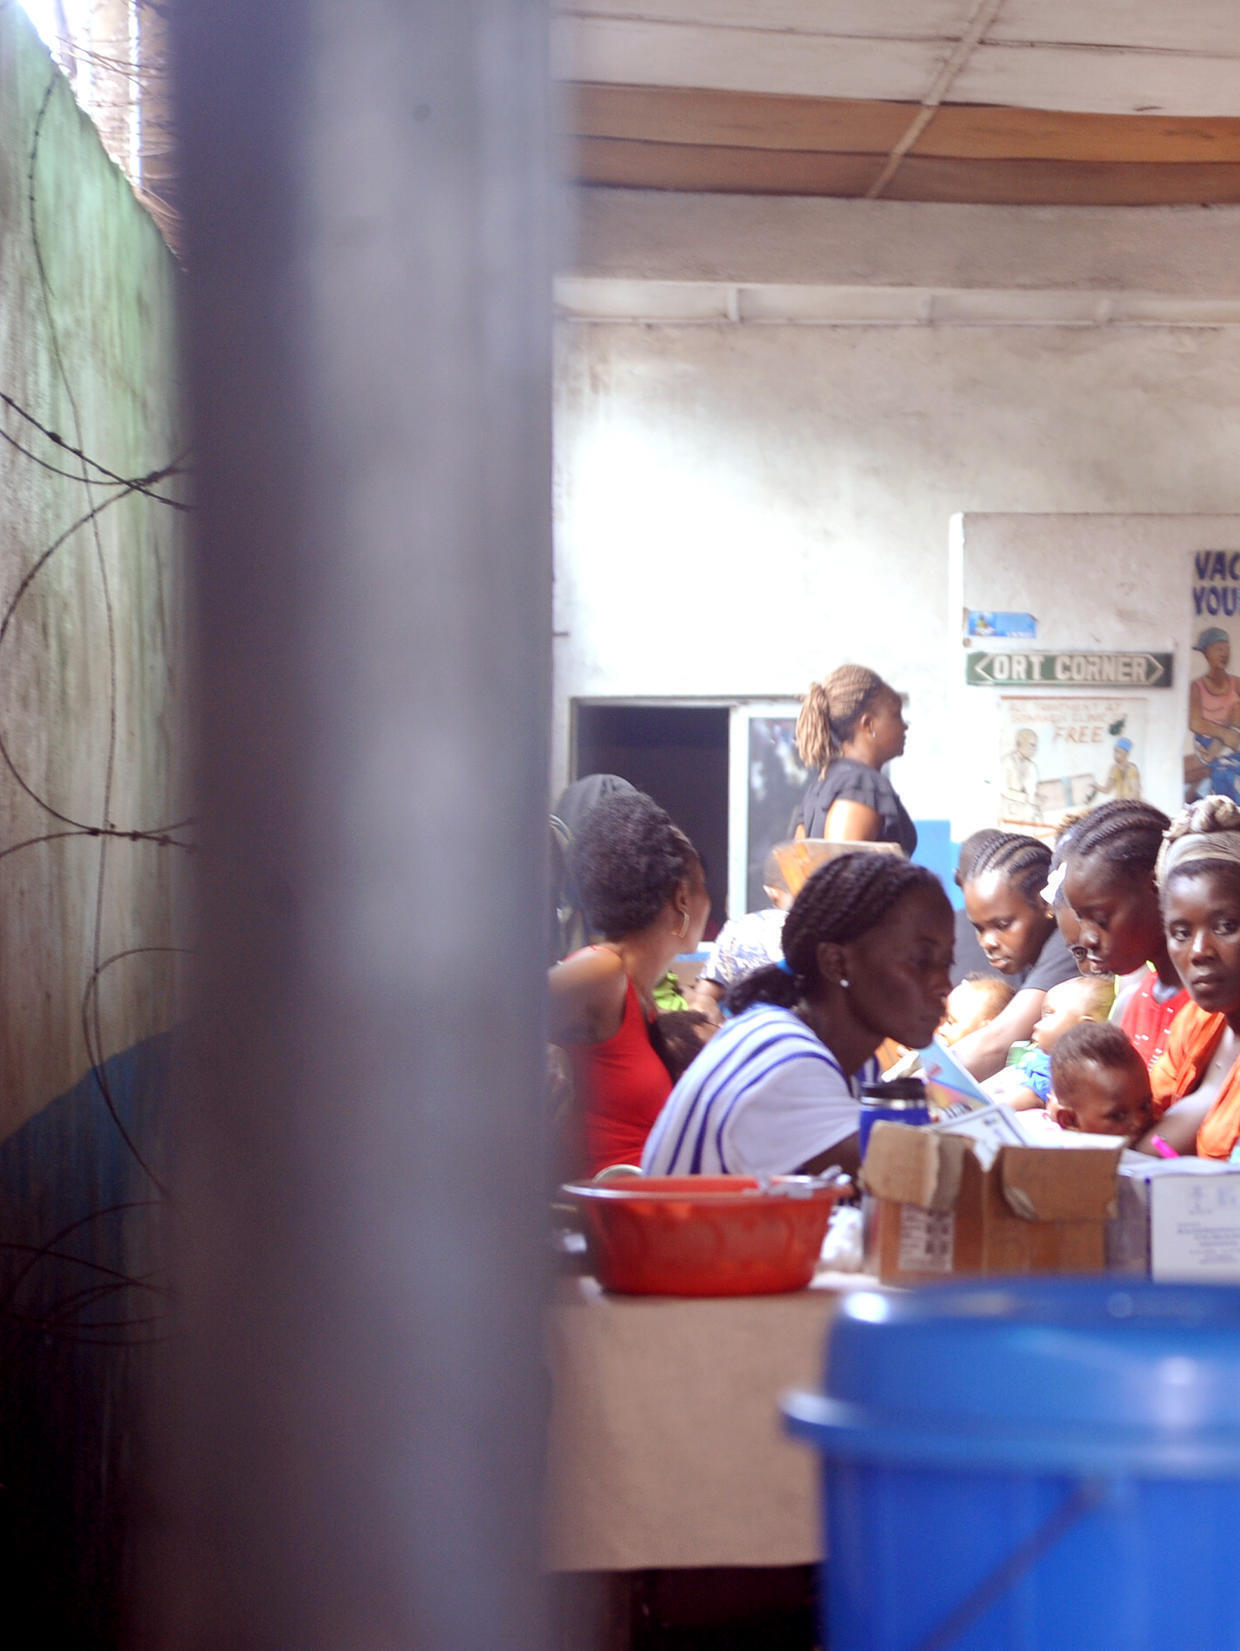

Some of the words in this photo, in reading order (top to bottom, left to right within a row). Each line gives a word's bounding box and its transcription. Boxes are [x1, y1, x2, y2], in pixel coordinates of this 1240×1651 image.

[992, 654, 1045, 682] ORT
[1054, 654, 1148, 682] CORNER
[1051, 725, 1104, 743] FREE
